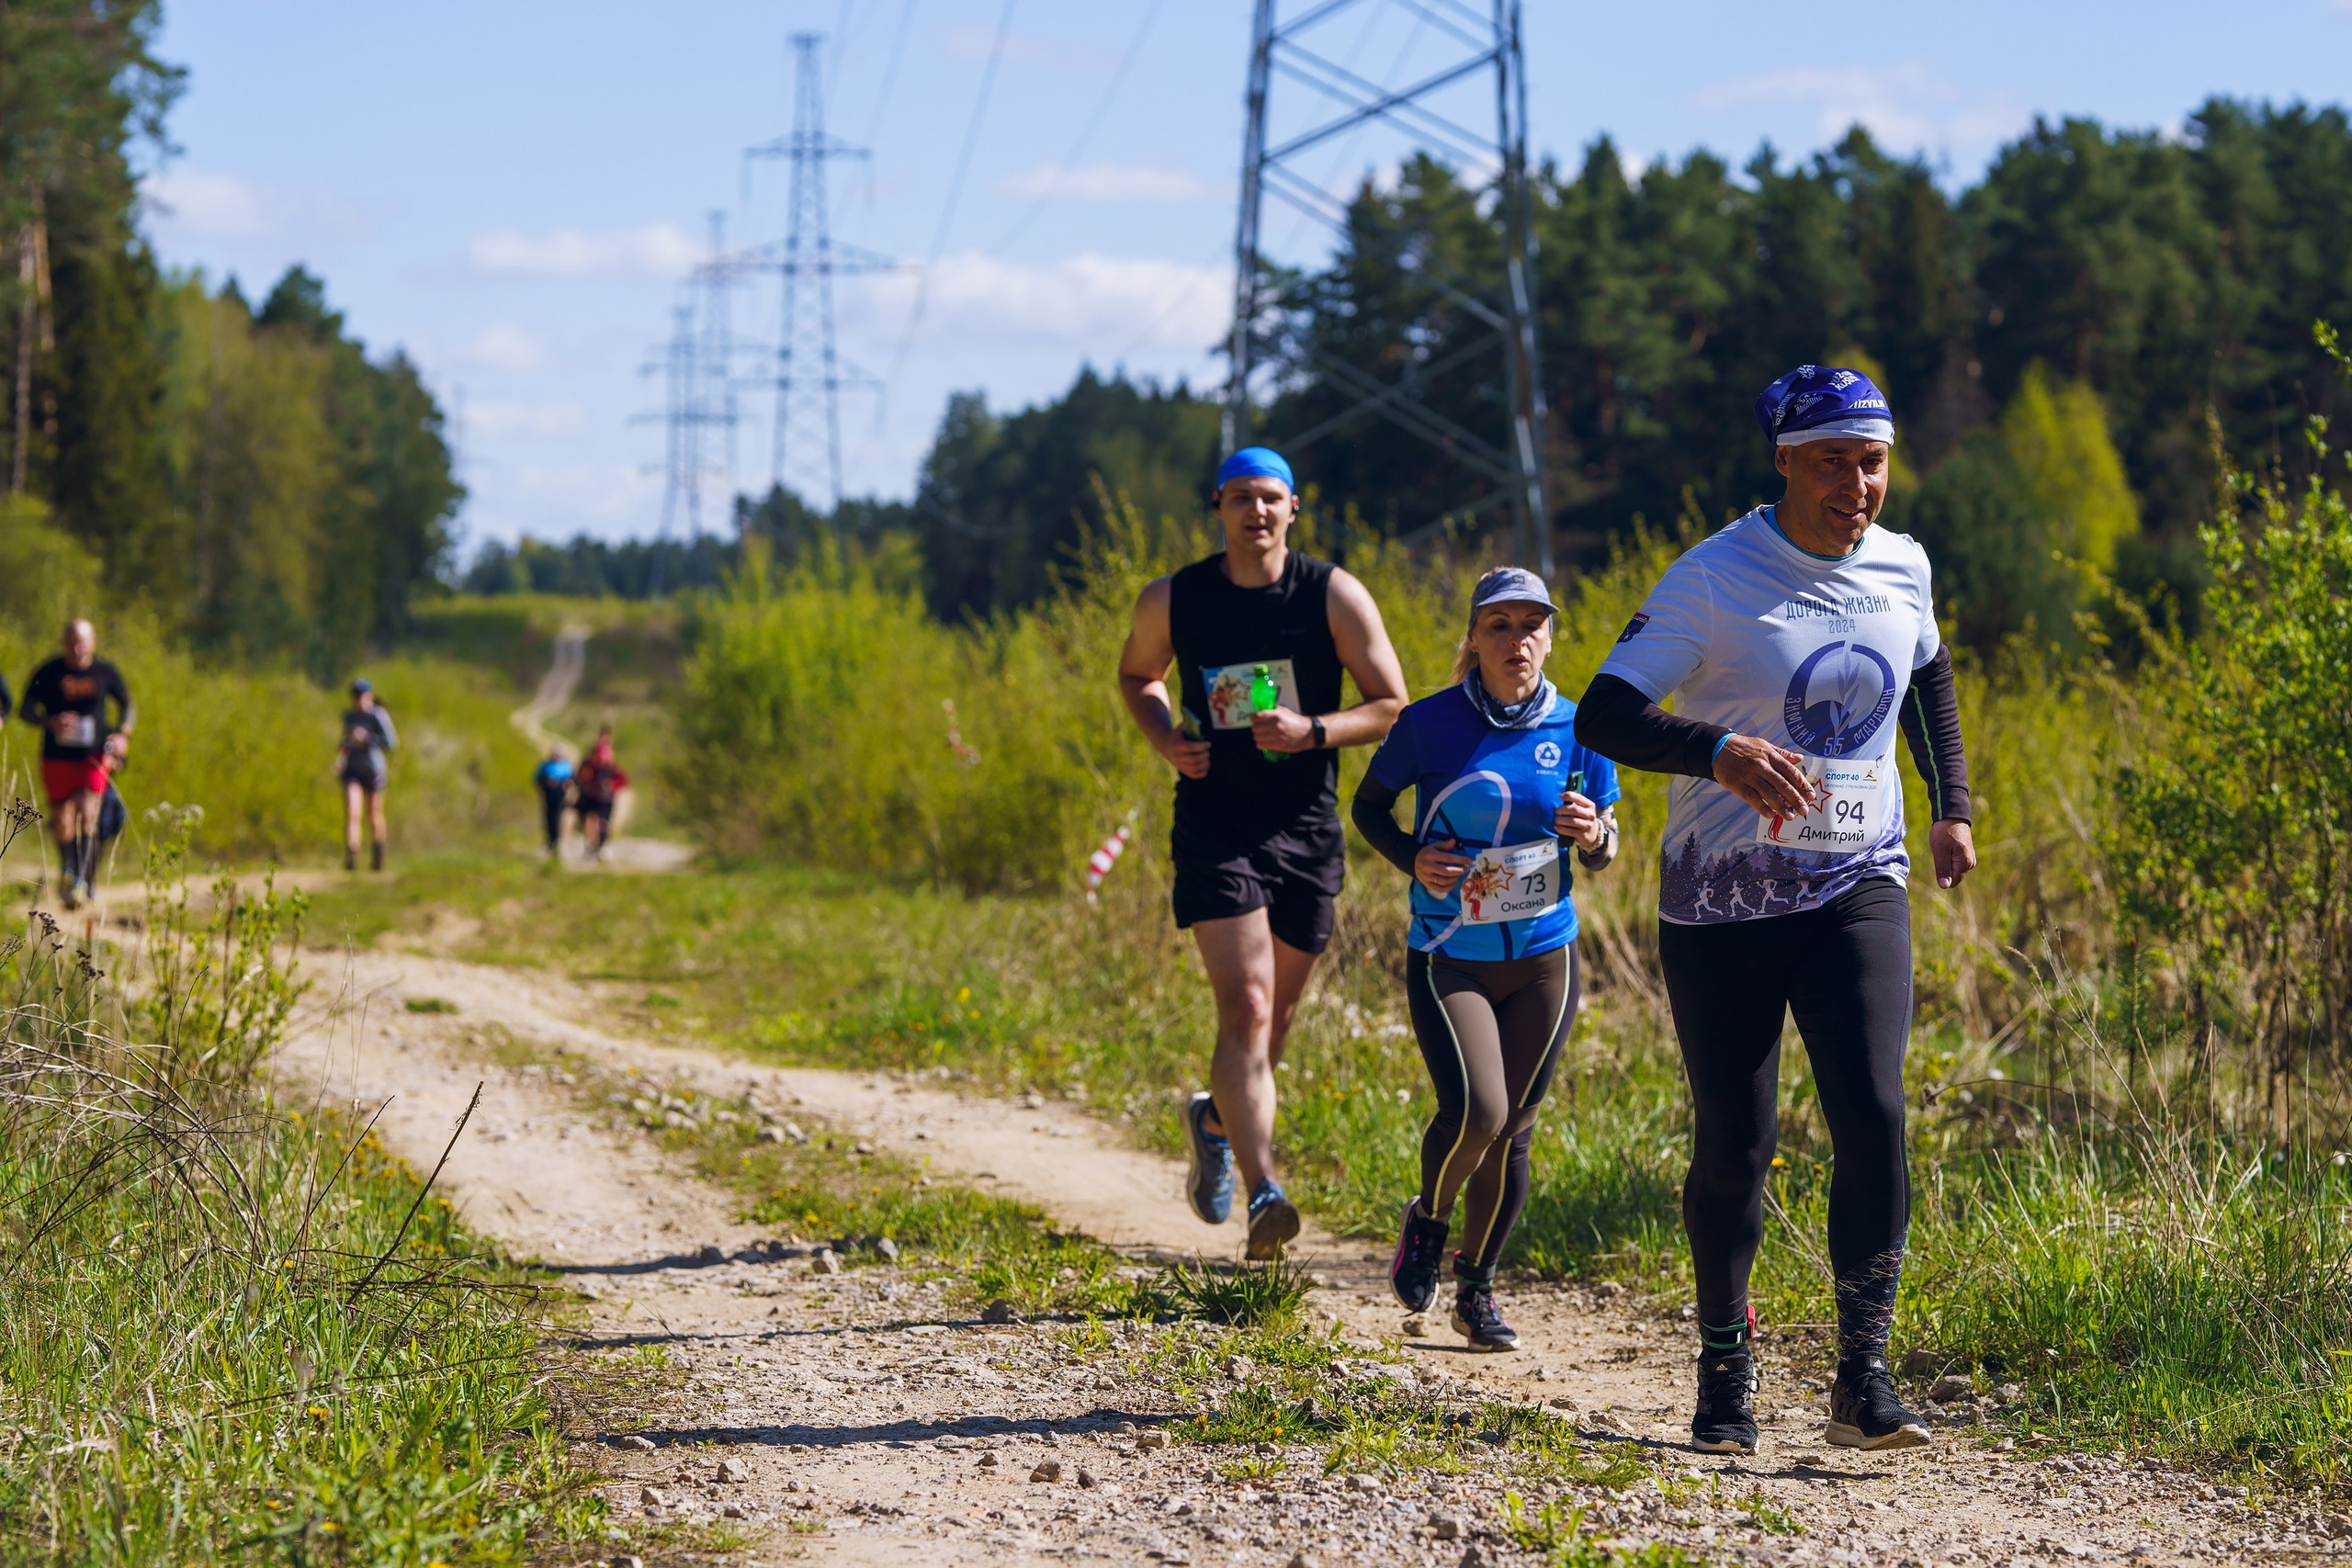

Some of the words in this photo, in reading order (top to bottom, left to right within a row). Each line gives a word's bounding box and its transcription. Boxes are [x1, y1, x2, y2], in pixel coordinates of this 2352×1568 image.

[1786, 599, 1840, 621] ДОРОГА
[1843, 594, 1891, 615] ЖИЗНИ
[1828, 618, 1856, 635] 2024
[1785, 696, 1816, 748] ЗИМНИЙ
[1853, 687, 1895, 745] МАРАФОН
[1836, 799, 1865, 825] 94
[1798, 826, 1865, 844] Дмитрий
[1521, 873, 1546, 896] 73
[1500, 897, 1545, 912] Оксана
